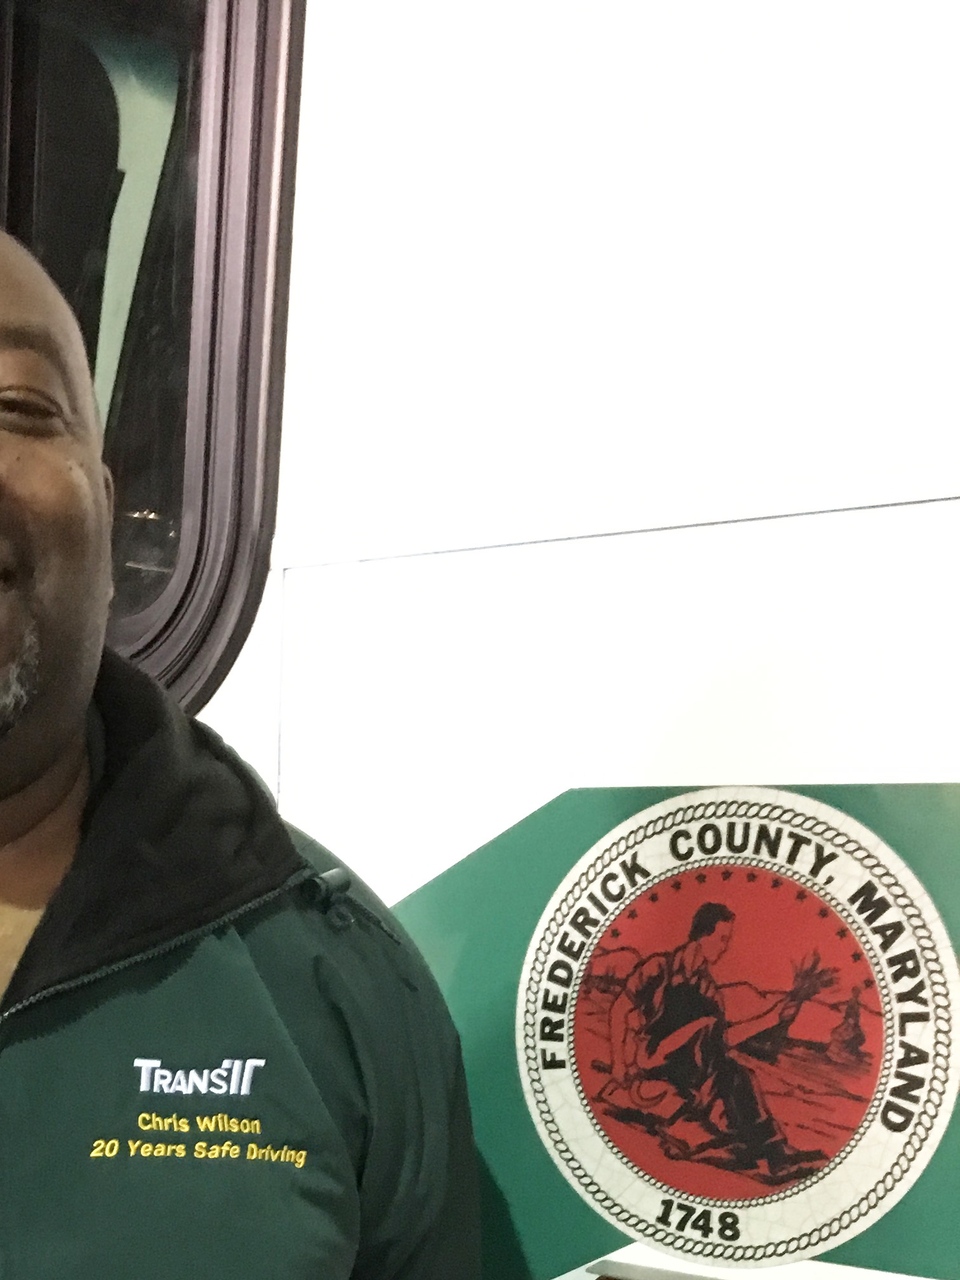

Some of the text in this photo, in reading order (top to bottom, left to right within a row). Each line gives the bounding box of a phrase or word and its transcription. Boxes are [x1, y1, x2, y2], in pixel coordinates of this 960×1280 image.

[540, 821, 930, 1133] FREDERICK COUNTY, MARYLAND
[138, 1112, 262, 1134] Chris Wilson
[90, 1138, 307, 1168] 20 Years Safe Driving
[655, 1199, 741, 1242] 1748
